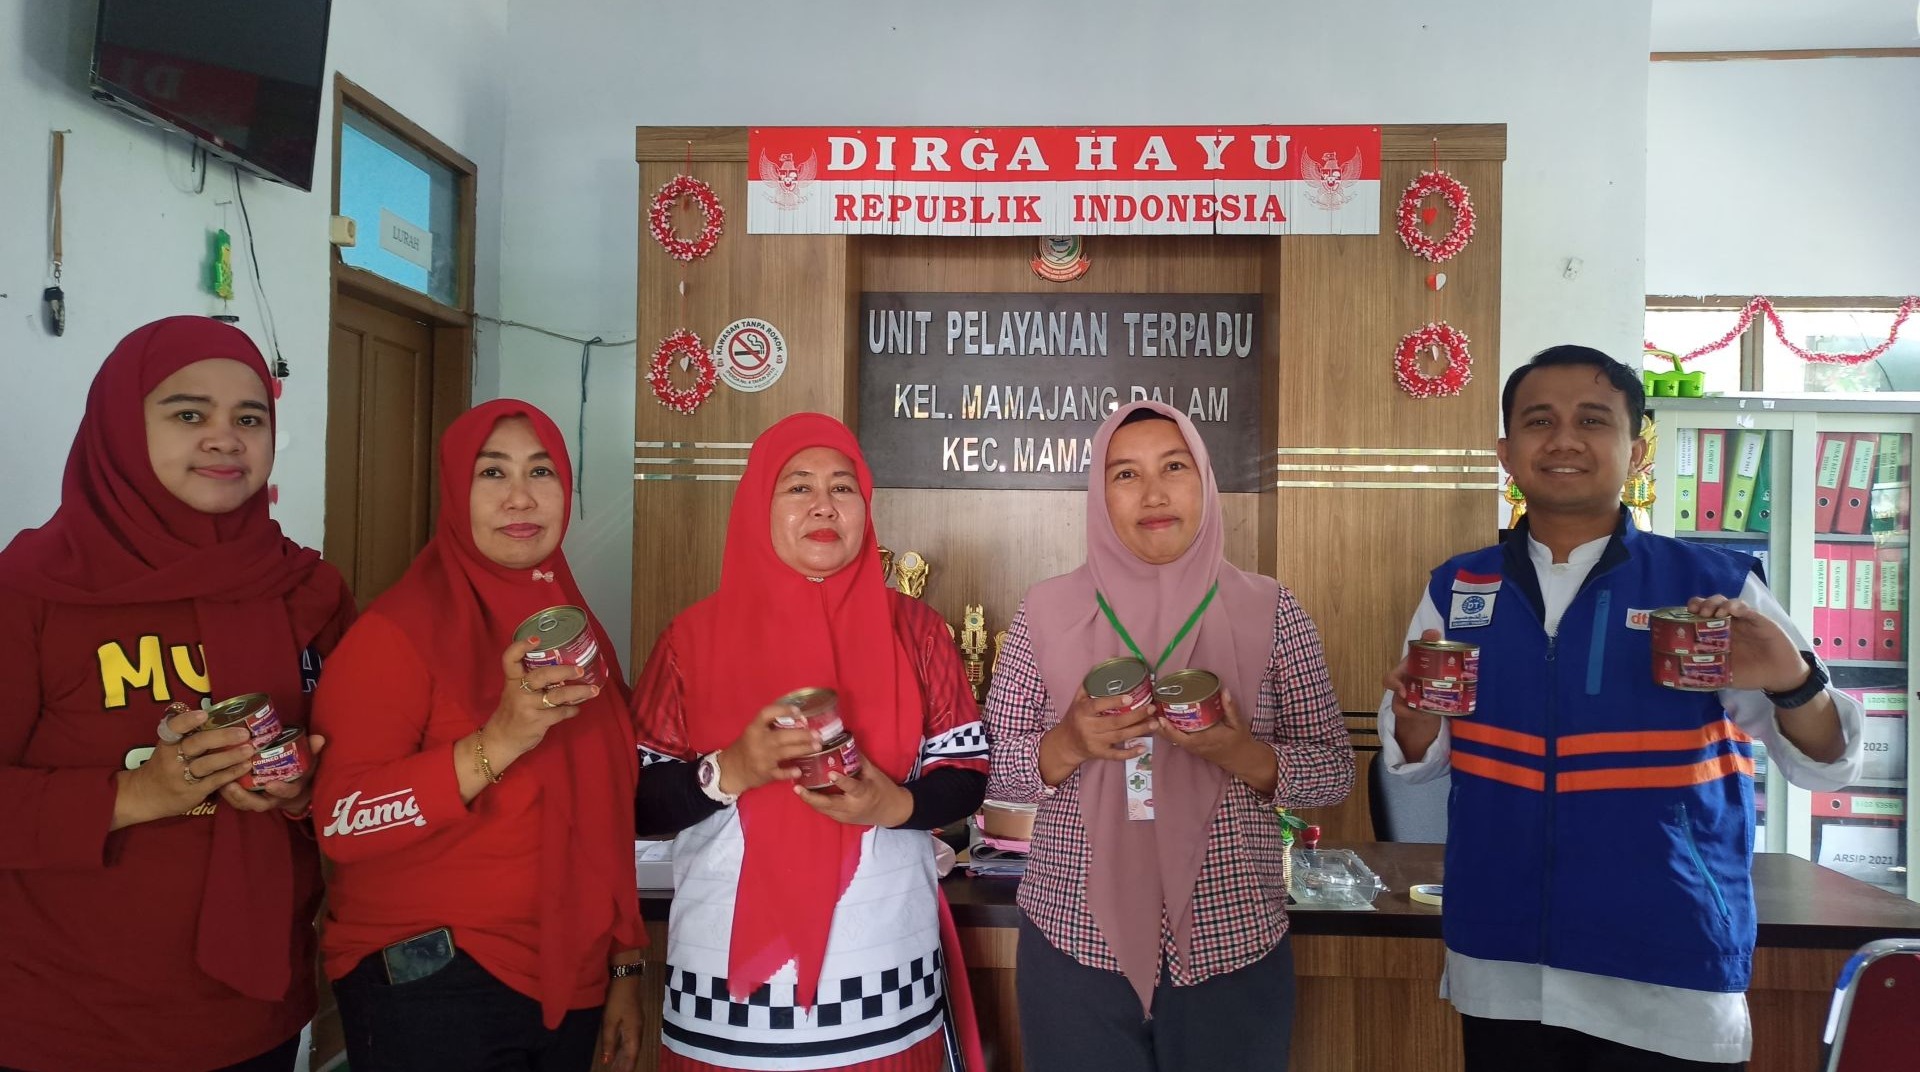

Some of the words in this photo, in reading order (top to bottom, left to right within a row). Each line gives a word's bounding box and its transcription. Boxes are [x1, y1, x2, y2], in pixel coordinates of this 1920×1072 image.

[834, 194, 1042, 223] REPUBLIK
[1073, 194, 1287, 222] INDONESIA
[716, 323, 740, 355] KAWASAN
[741, 321, 765, 330] TANPA
[765, 328, 784, 352] ROKOK
[868, 310, 932, 355] UNIT
[946, 311, 1108, 357] PELAYANAN
[1123, 312, 1253, 358] TERPADU
[894, 383, 954, 420] KEL.
[961, 385, 1120, 421] MAMAJANG
[942, 436, 1006, 473] KEC.
[252, 755, 279, 766] CORNED
[1863, 742, 1889, 752] 2023
[1833, 853, 1866, 863] ARSIP
[1868, 855, 1893, 865] 2021
